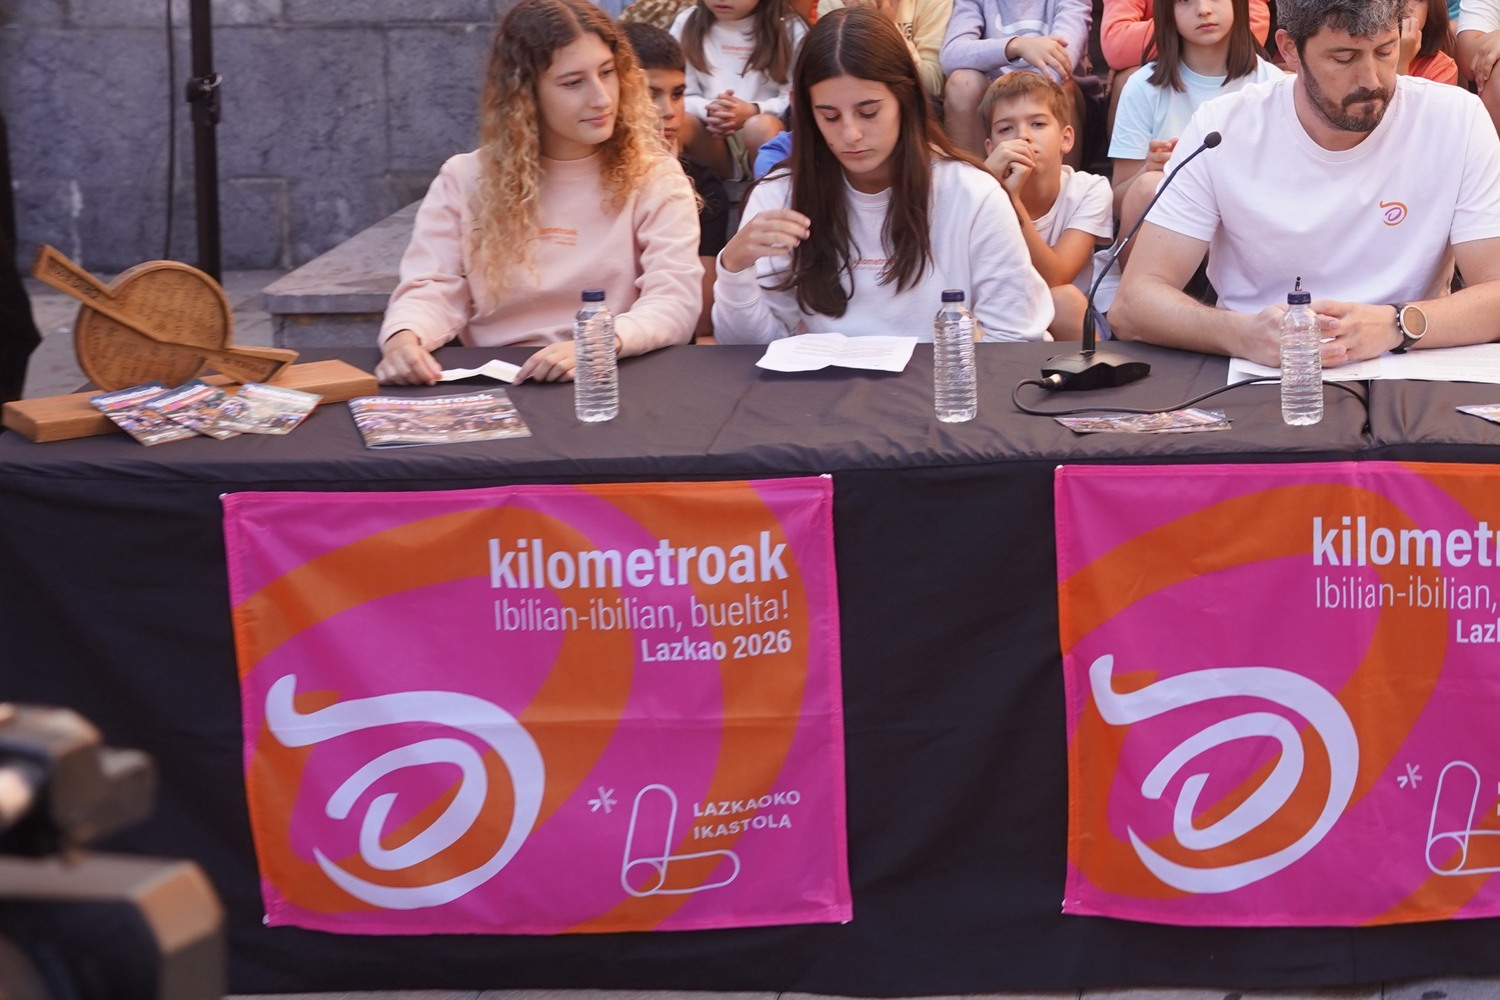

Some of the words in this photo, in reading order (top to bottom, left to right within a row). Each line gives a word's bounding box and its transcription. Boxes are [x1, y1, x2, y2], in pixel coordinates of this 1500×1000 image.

[489, 531, 788, 589] kilometroak
[494, 597, 683, 633] Ibilian-ibilian,
[690, 590, 789, 628] buelta!
[1315, 575, 1497, 614] Ibilian-ibilian,
[641, 637, 727, 663] Lazkao
[732, 630, 792, 660] 2026
[693, 790, 801, 818] LAZKAOKO
[693, 815, 792, 840] IKASTOLA
